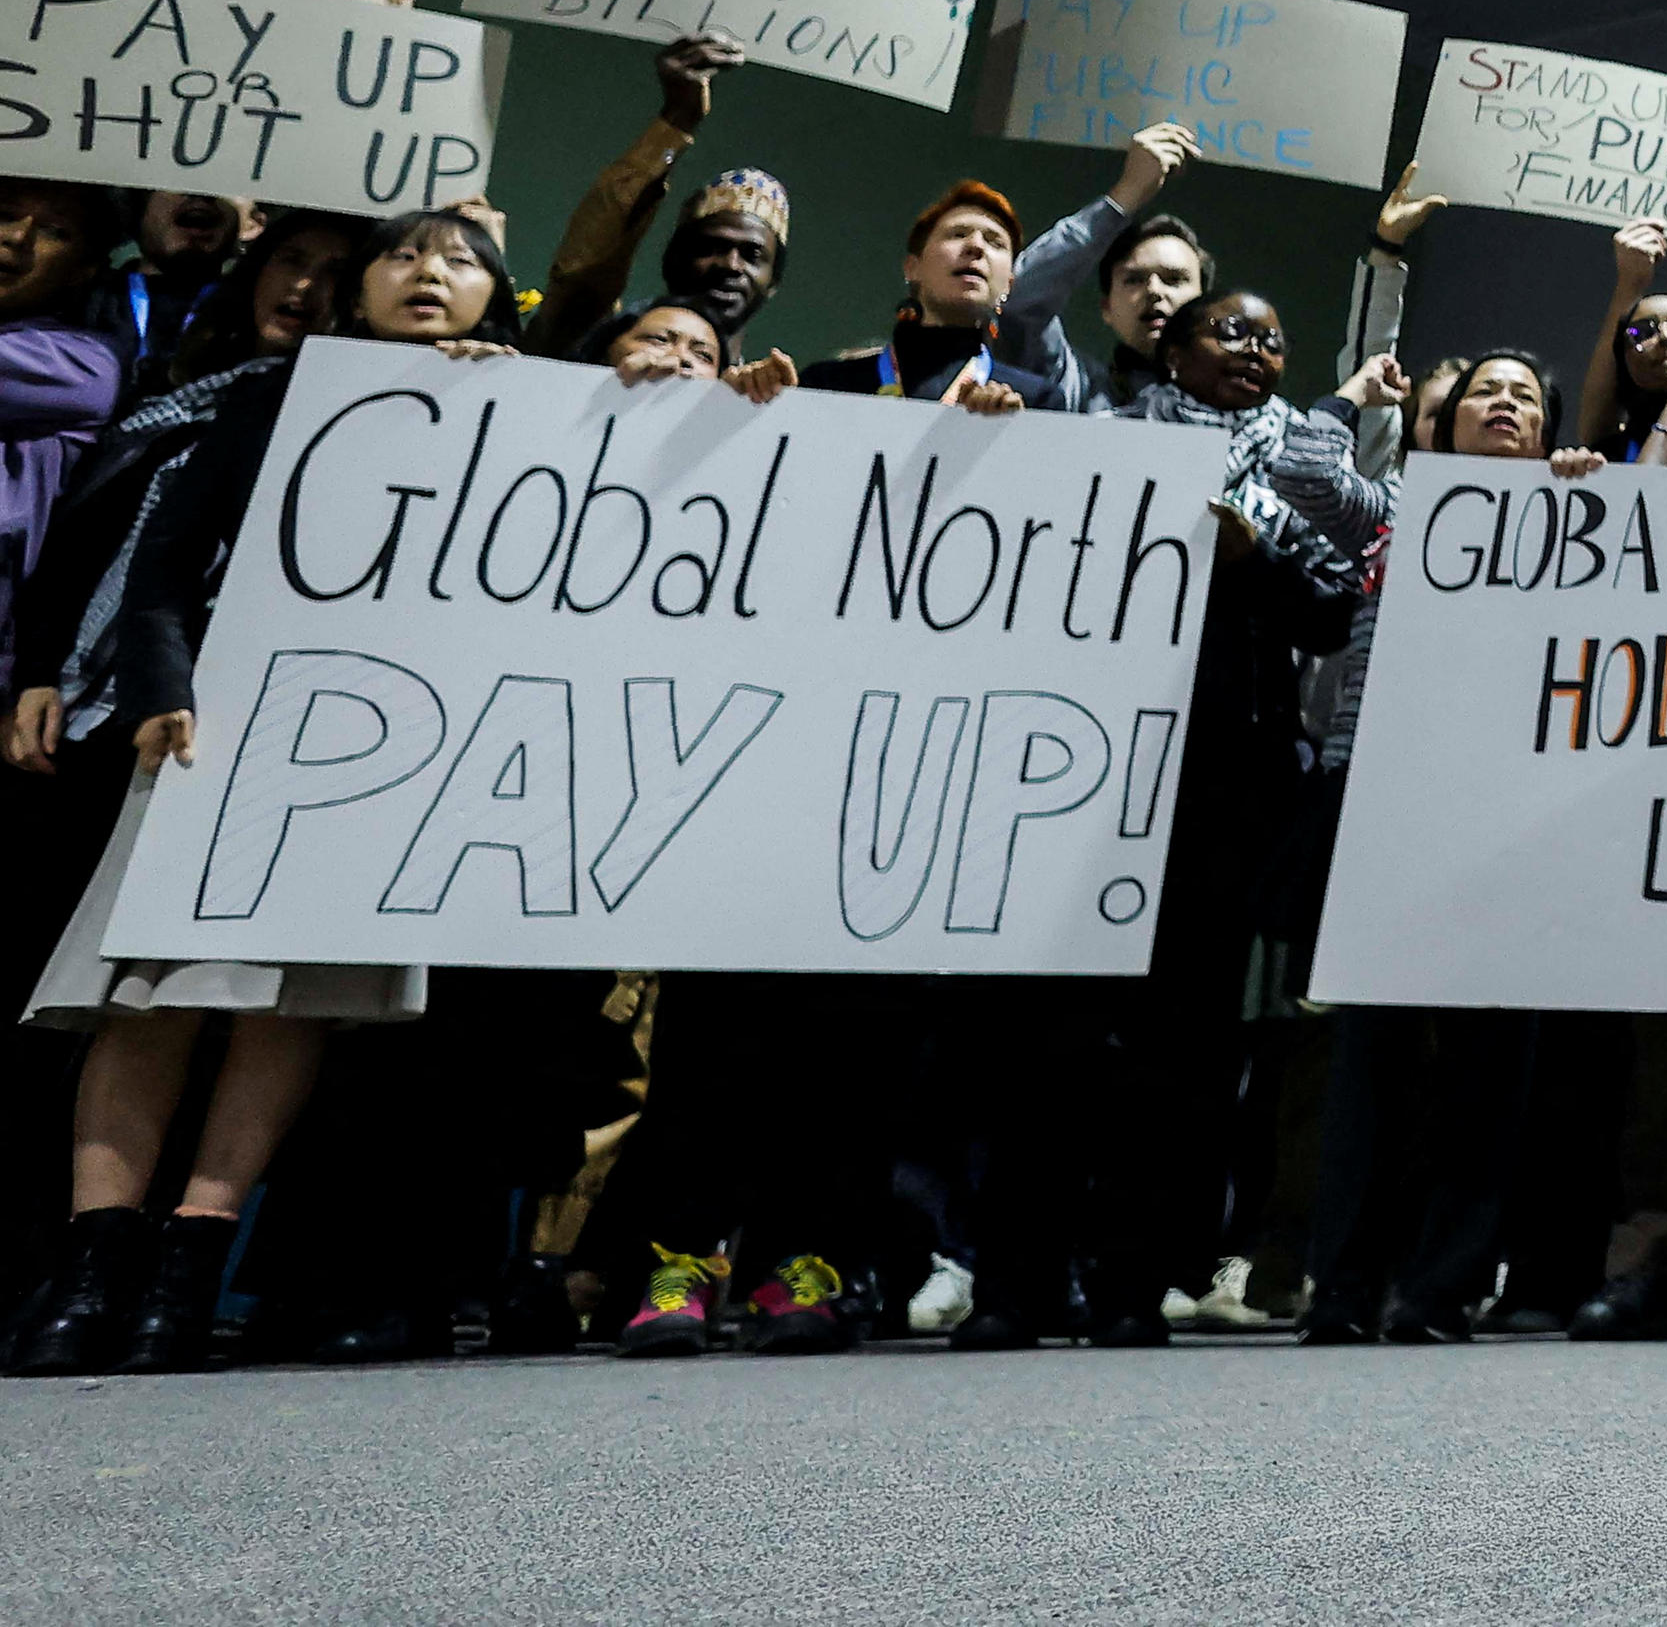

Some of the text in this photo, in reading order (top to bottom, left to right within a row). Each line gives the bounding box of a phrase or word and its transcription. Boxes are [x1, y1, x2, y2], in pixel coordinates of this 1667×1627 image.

[1180, 1, 1276, 48] UP
[171, 71, 279, 108] OR
[337, 30, 460, 114] UP
[1034, 52, 1237, 106] UBLIC
[1459, 48, 1608, 104] STAND
[0, 58, 479, 209] SHUT UP
[1029, 102, 1313, 168] FINNCE
[1474, 94, 1556, 141] FOR
[278, 387, 1191, 646] Global North
[194, 648, 1179, 943] PAY UP!
